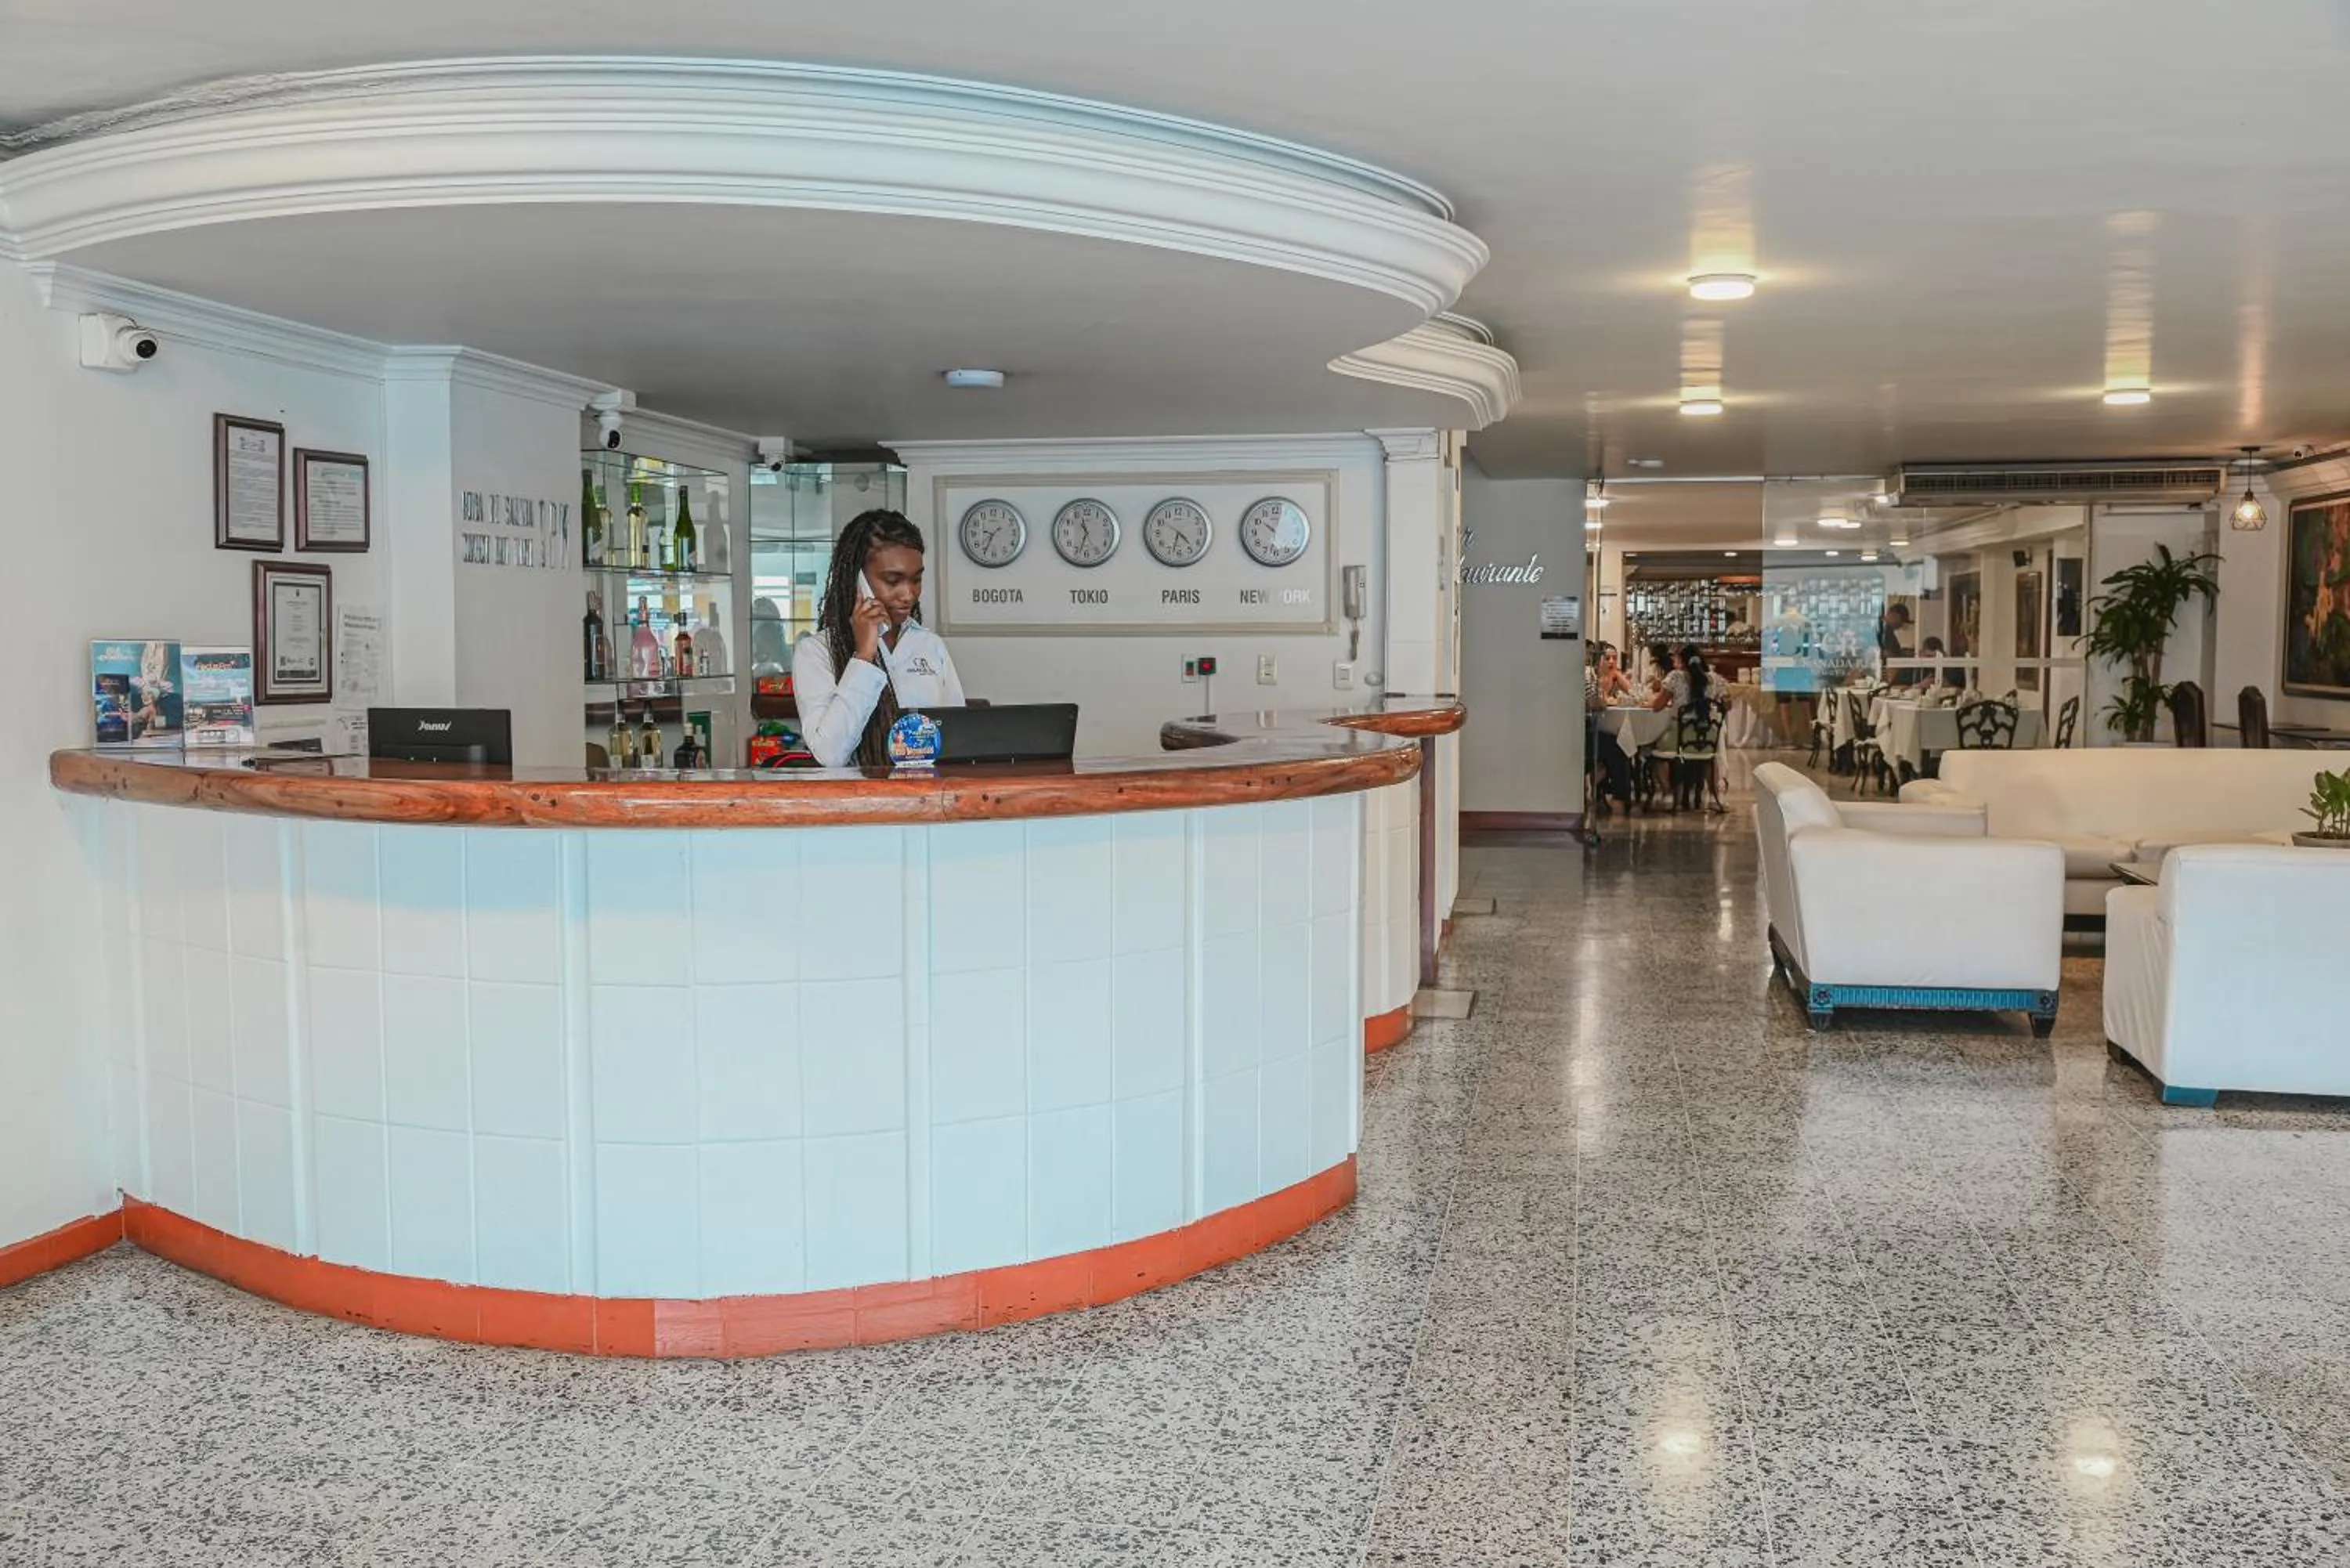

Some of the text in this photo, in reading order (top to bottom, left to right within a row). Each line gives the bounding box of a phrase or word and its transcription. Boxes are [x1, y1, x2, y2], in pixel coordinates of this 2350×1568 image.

[972, 588, 1024, 603] BOGOTA
[1068, 589, 1108, 604] TOKIO
[1162, 589, 1200, 604] PARIS
[1240, 589, 1311, 605] NEW ORK
